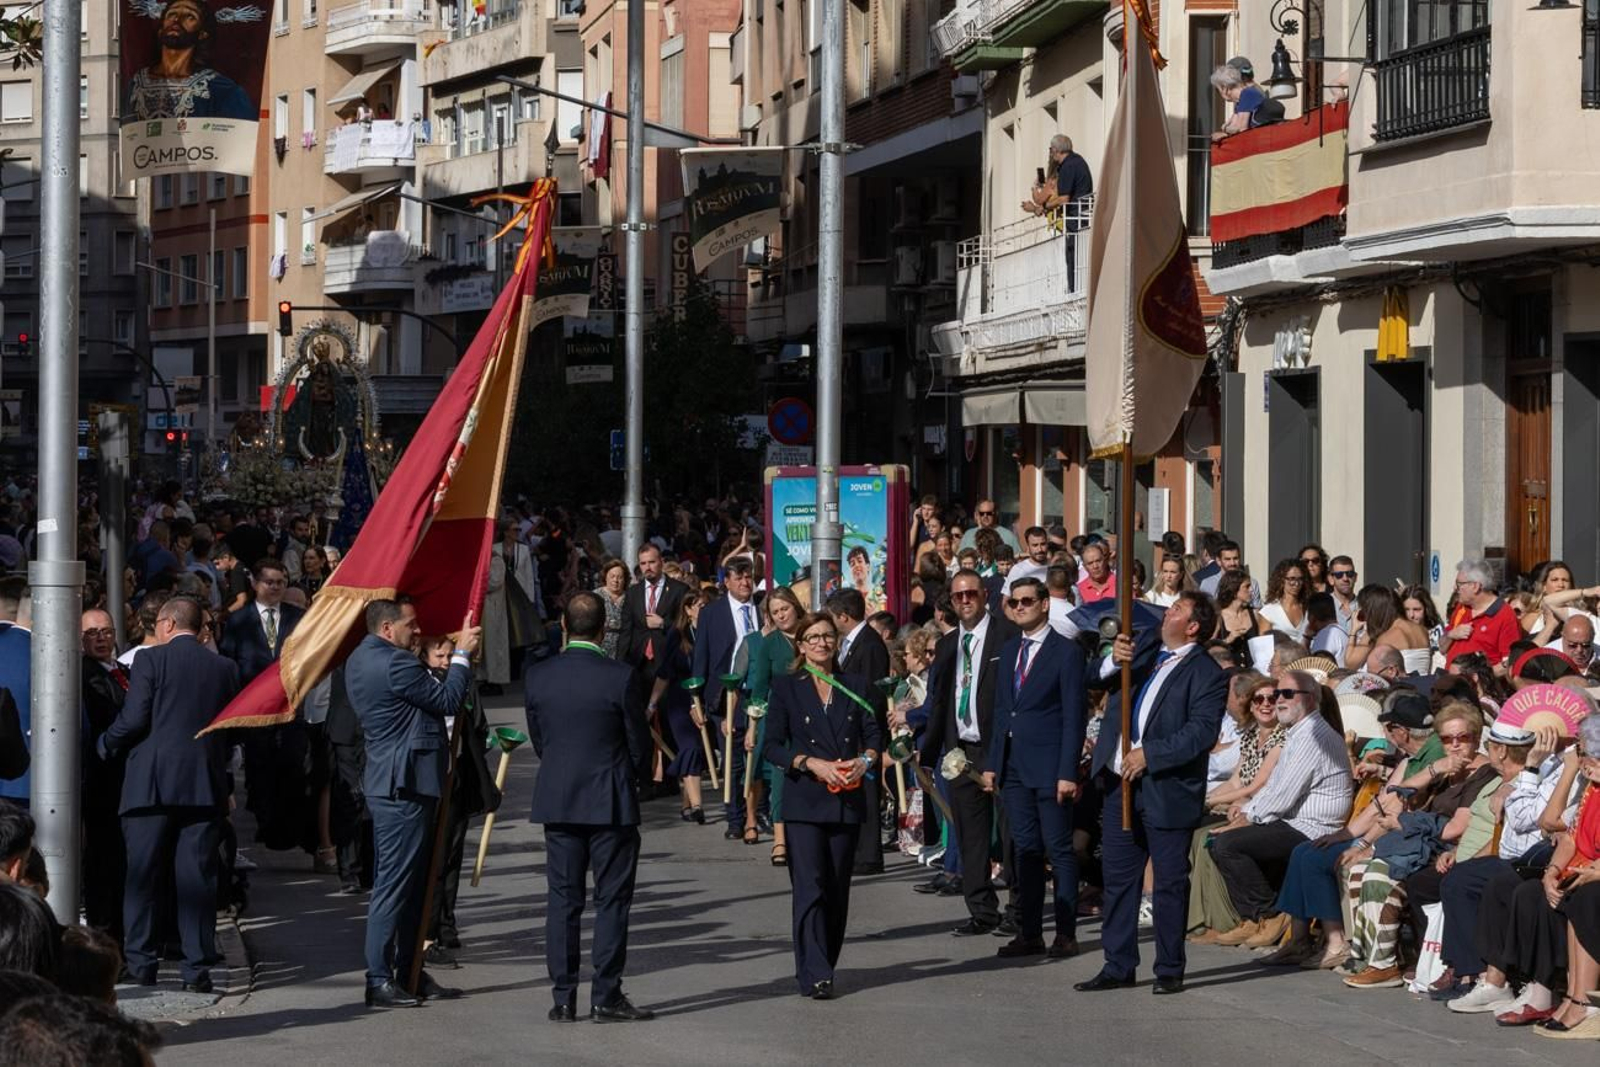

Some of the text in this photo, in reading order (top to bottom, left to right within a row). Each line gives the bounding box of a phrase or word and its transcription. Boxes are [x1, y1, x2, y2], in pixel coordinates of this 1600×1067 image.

[850, 483, 872, 492] JOVEN
[787, 523, 812, 542] VENT
[1513, 687, 1542, 713] QUÉ
